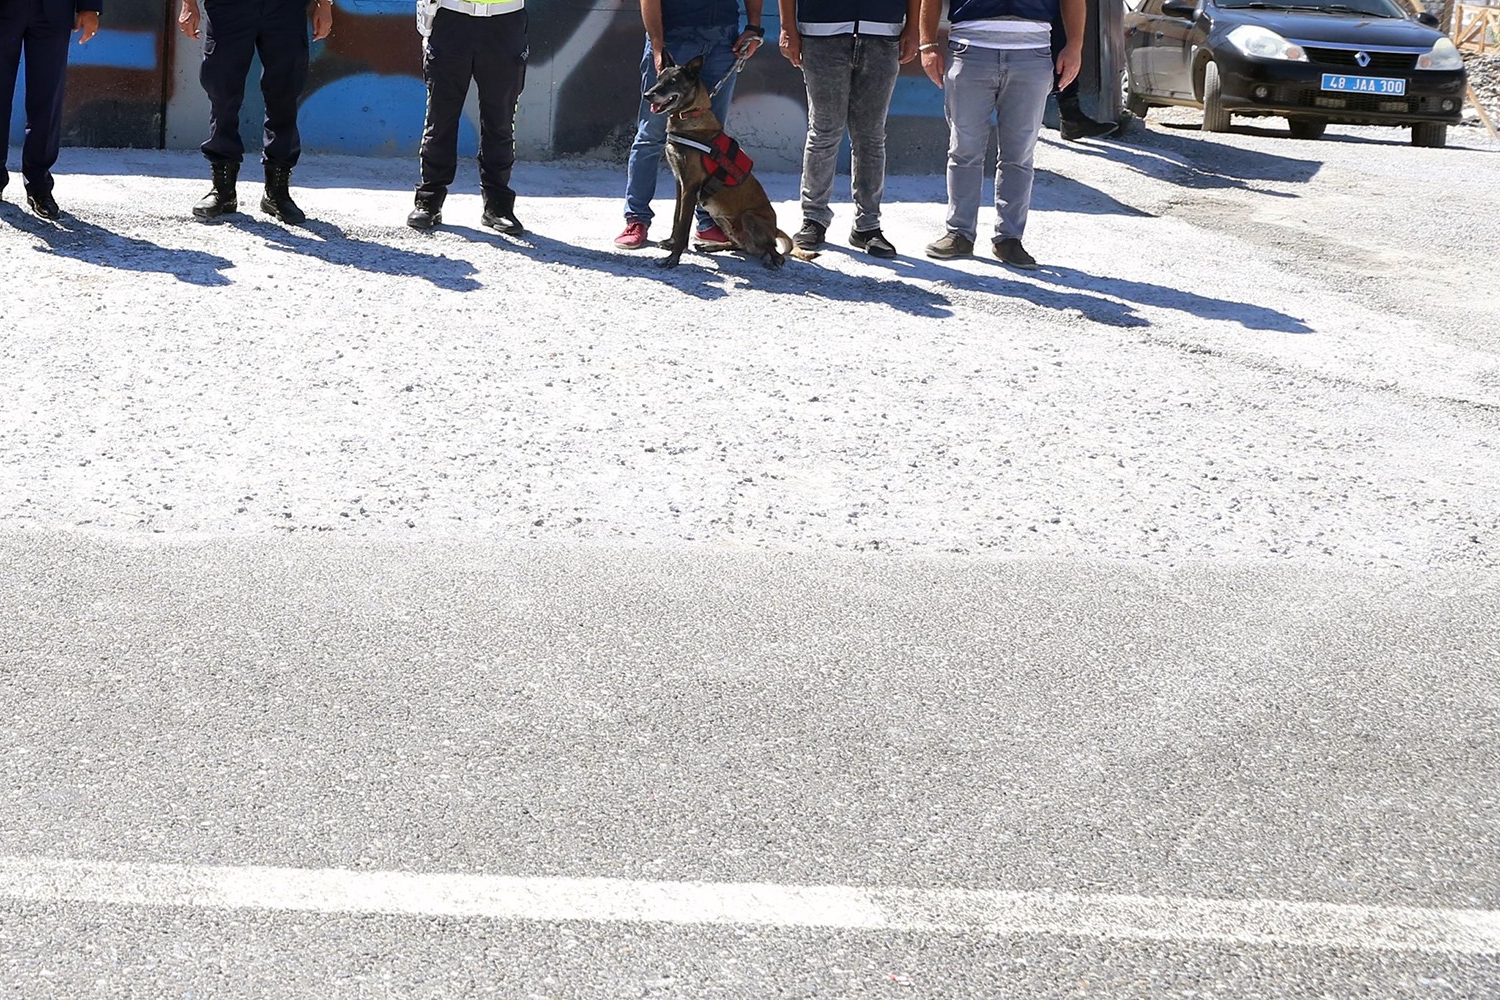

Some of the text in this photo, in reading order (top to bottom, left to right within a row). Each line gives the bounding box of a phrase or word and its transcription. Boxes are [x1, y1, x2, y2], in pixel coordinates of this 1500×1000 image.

[1330, 77, 1402, 93] 48 JAA 300
